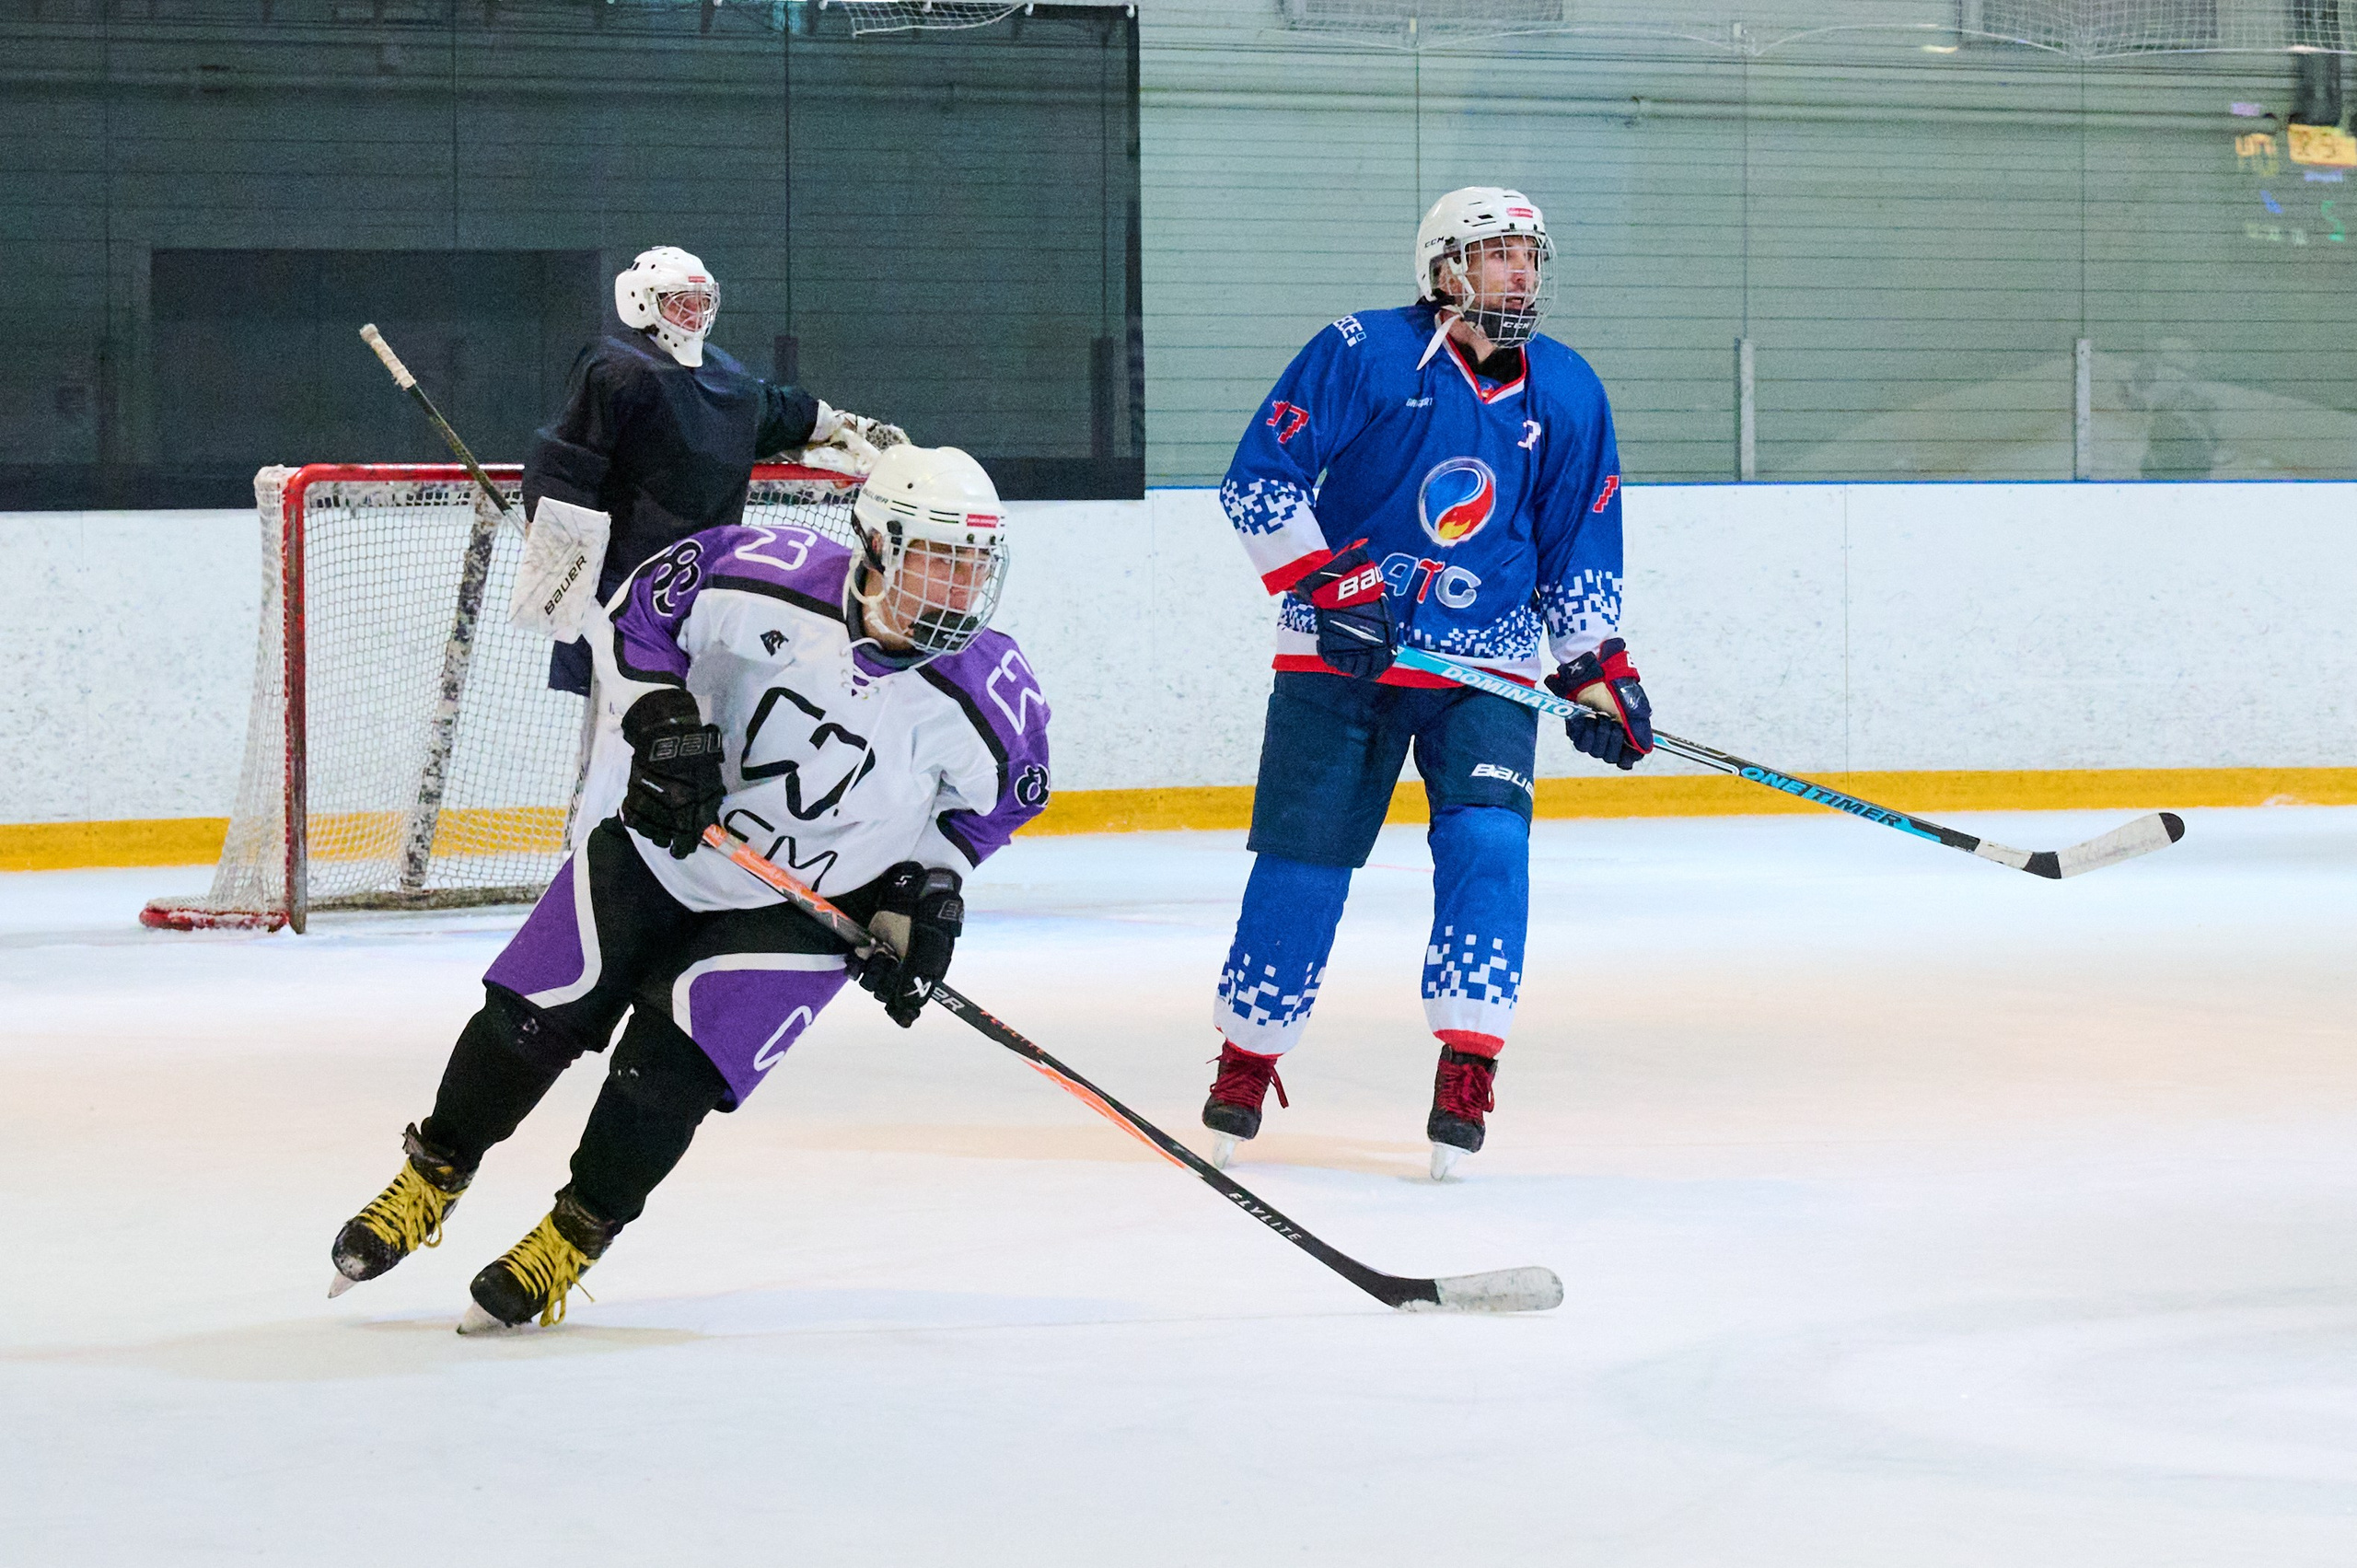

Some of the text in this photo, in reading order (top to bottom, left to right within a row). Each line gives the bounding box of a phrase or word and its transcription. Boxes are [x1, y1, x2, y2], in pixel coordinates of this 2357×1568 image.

[1423, 236, 1445, 249] CCM
[544, 554, 588, 616] BAUER
[1741, 766, 1902, 827] ONE TIMER
[1228, 1191, 1303, 1241] FLYLITE
